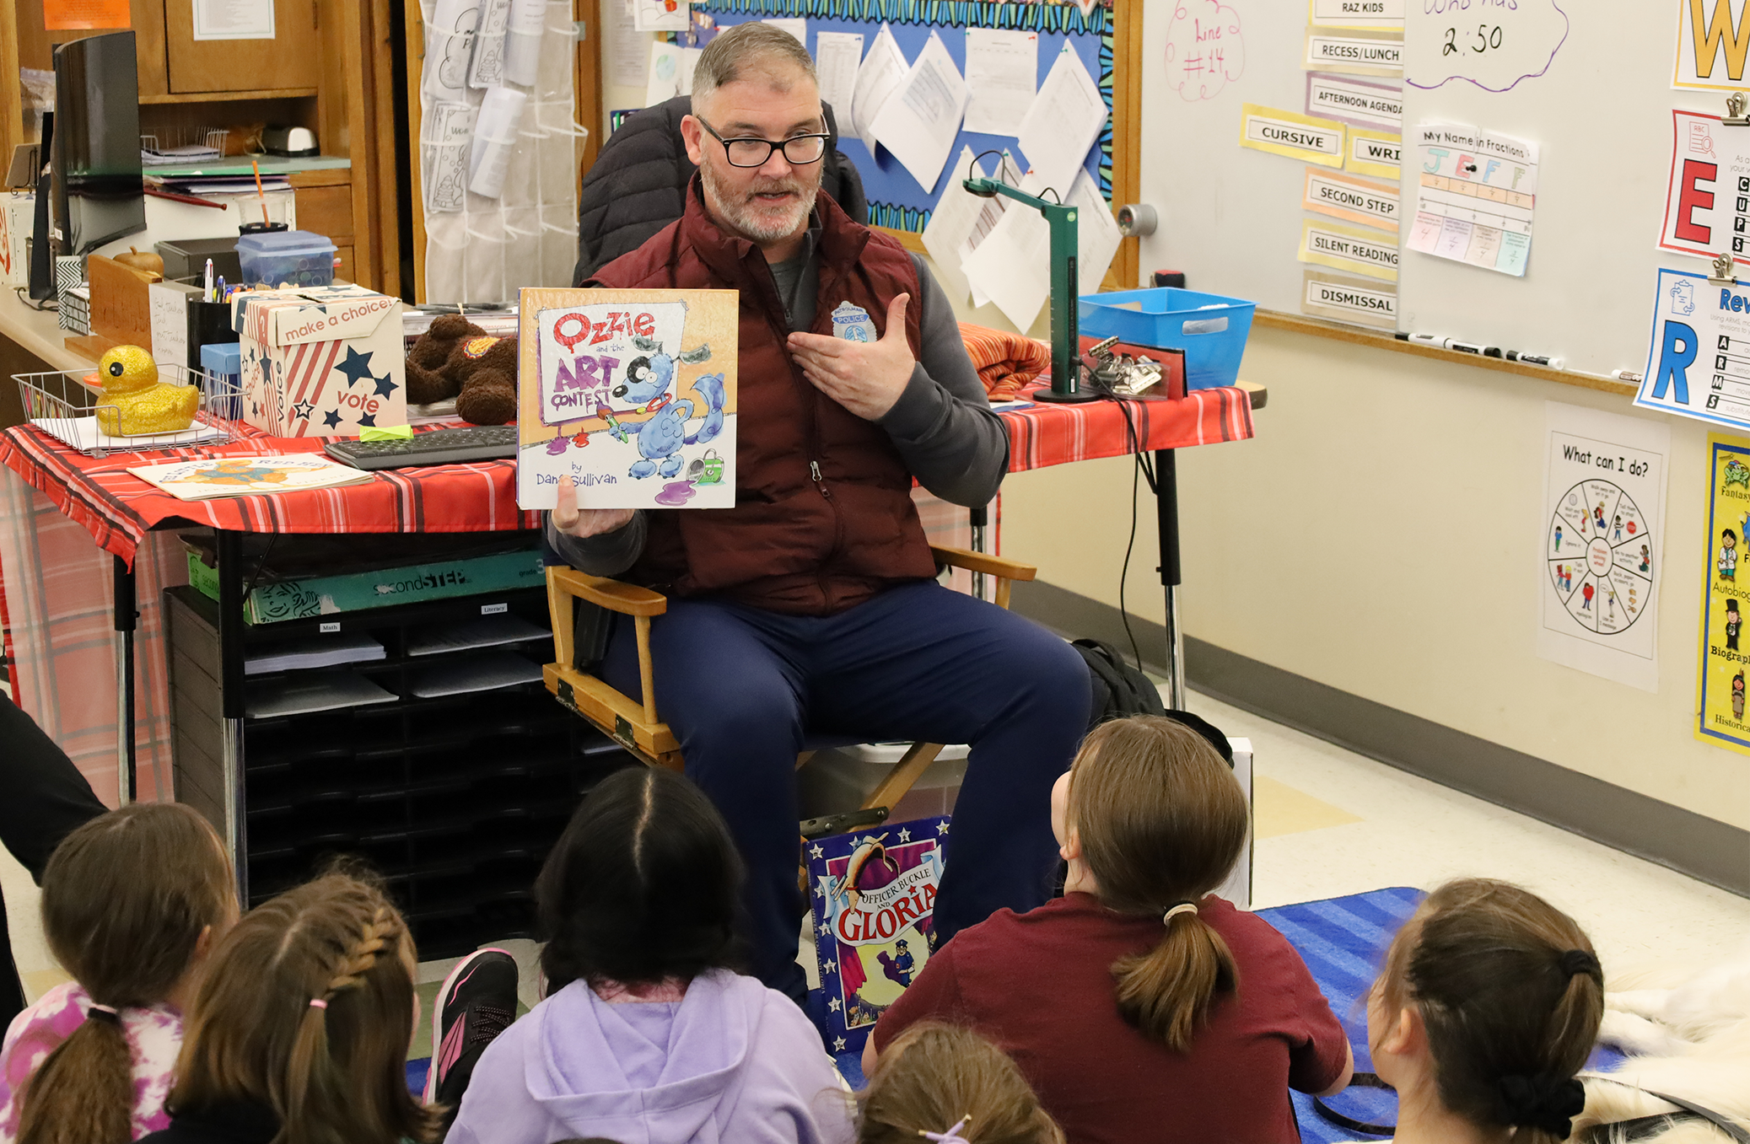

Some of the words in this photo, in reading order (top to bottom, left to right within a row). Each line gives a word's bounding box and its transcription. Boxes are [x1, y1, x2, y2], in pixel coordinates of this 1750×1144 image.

[1342, 2, 1360, 13] RAZ
[1362, 2, 1384, 13] KIDS
[1481, 0, 1518, 11] as
[1195, 18, 1222, 42] Line
[1442, 24, 1502, 57] 2:50
[1689, 0, 1750, 81] W
[1183, 48, 1225, 79] #14
[1322, 44, 1400, 62] RECESS/LUNCH
[1318, 91, 1368, 109] AFTERNOON
[1369, 101, 1402, 115] AGENDA
[1262, 127, 1324, 148] CURSIVE
[1423, 130, 1441, 142] My
[1444, 132, 1474, 146] Name
[1476, 137, 1485, 148] in
[1486, 139, 1525, 159] Fractions
[1739, 177, 1748, 190] C
[1320, 187, 1364, 207] SECOND
[1366, 198, 1394, 214] STEP
[1674, 158, 1718, 245] E
[1737, 198, 1746, 211] U
[1736, 217, 1744, 230] P
[1315, 237, 1350, 254] SILENT
[1352, 245, 1399, 265] READING
[1734, 238, 1742, 251] S
[1321, 289, 1394, 312] DISMISSAL
[285, 320, 325, 342] make
[328, 315, 339, 327] a
[341, 299, 393, 322] choice!
[837, 316, 865, 324] POLICE
[553, 311, 656, 354] Ozzie
[1719, 336, 1728, 349] A
[596, 344, 609, 353] and
[610, 343, 625, 352] the
[553, 354, 621, 393] ART
[1651, 320, 1698, 405] R
[1717, 357, 1725, 369] R
[276, 360, 285, 422] voice
[1712, 376, 1723, 388] M
[337, 390, 380, 413] vote
[551, 388, 613, 414] CONTEST
[1708, 396, 1717, 408] S
[571, 461, 583, 474] by
[1562, 444, 1592, 465] What
[1595, 456, 1614, 471] can
[1618, 456, 1625, 472] I
[1628, 459, 1649, 478] do?
[571, 472, 617, 487] Sullivan
[536, 559, 545, 575] 3
[373, 569, 466, 596] scondSTEP
[862, 886, 899, 904] OFFICER
[898, 868, 931, 891] BUCKLE
[876, 901, 891, 910] AND
